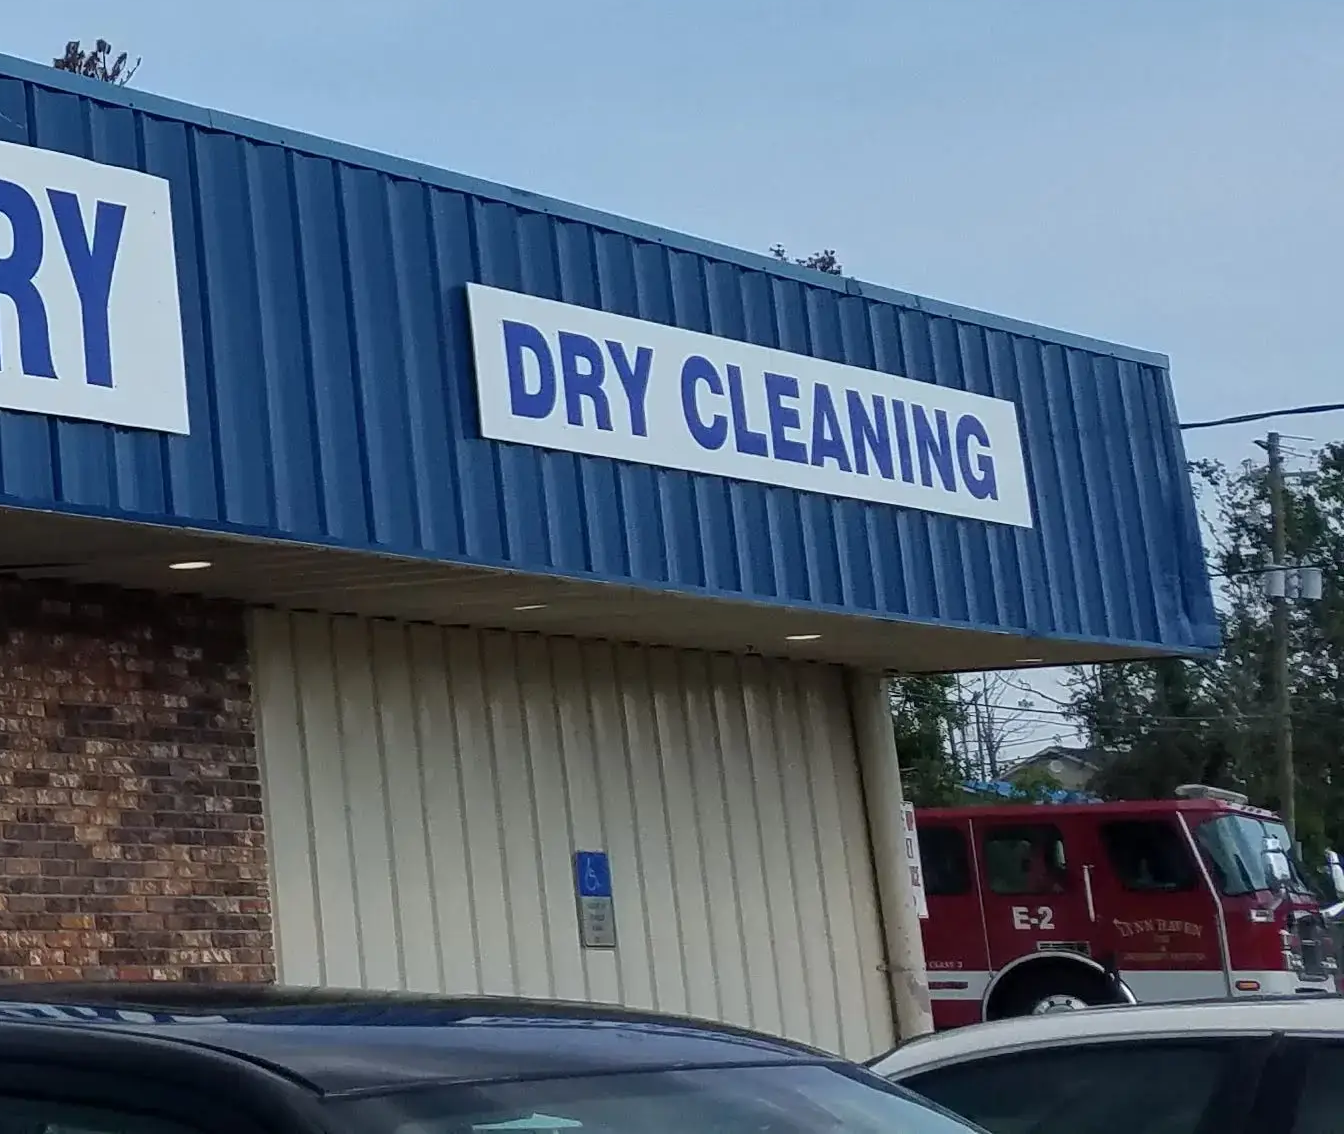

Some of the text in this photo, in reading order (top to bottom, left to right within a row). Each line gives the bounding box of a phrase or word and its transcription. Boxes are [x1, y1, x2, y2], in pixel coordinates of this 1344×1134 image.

[502, 319, 999, 502] DRY CLEANING
[1012, 906, 1055, 930] E-2
